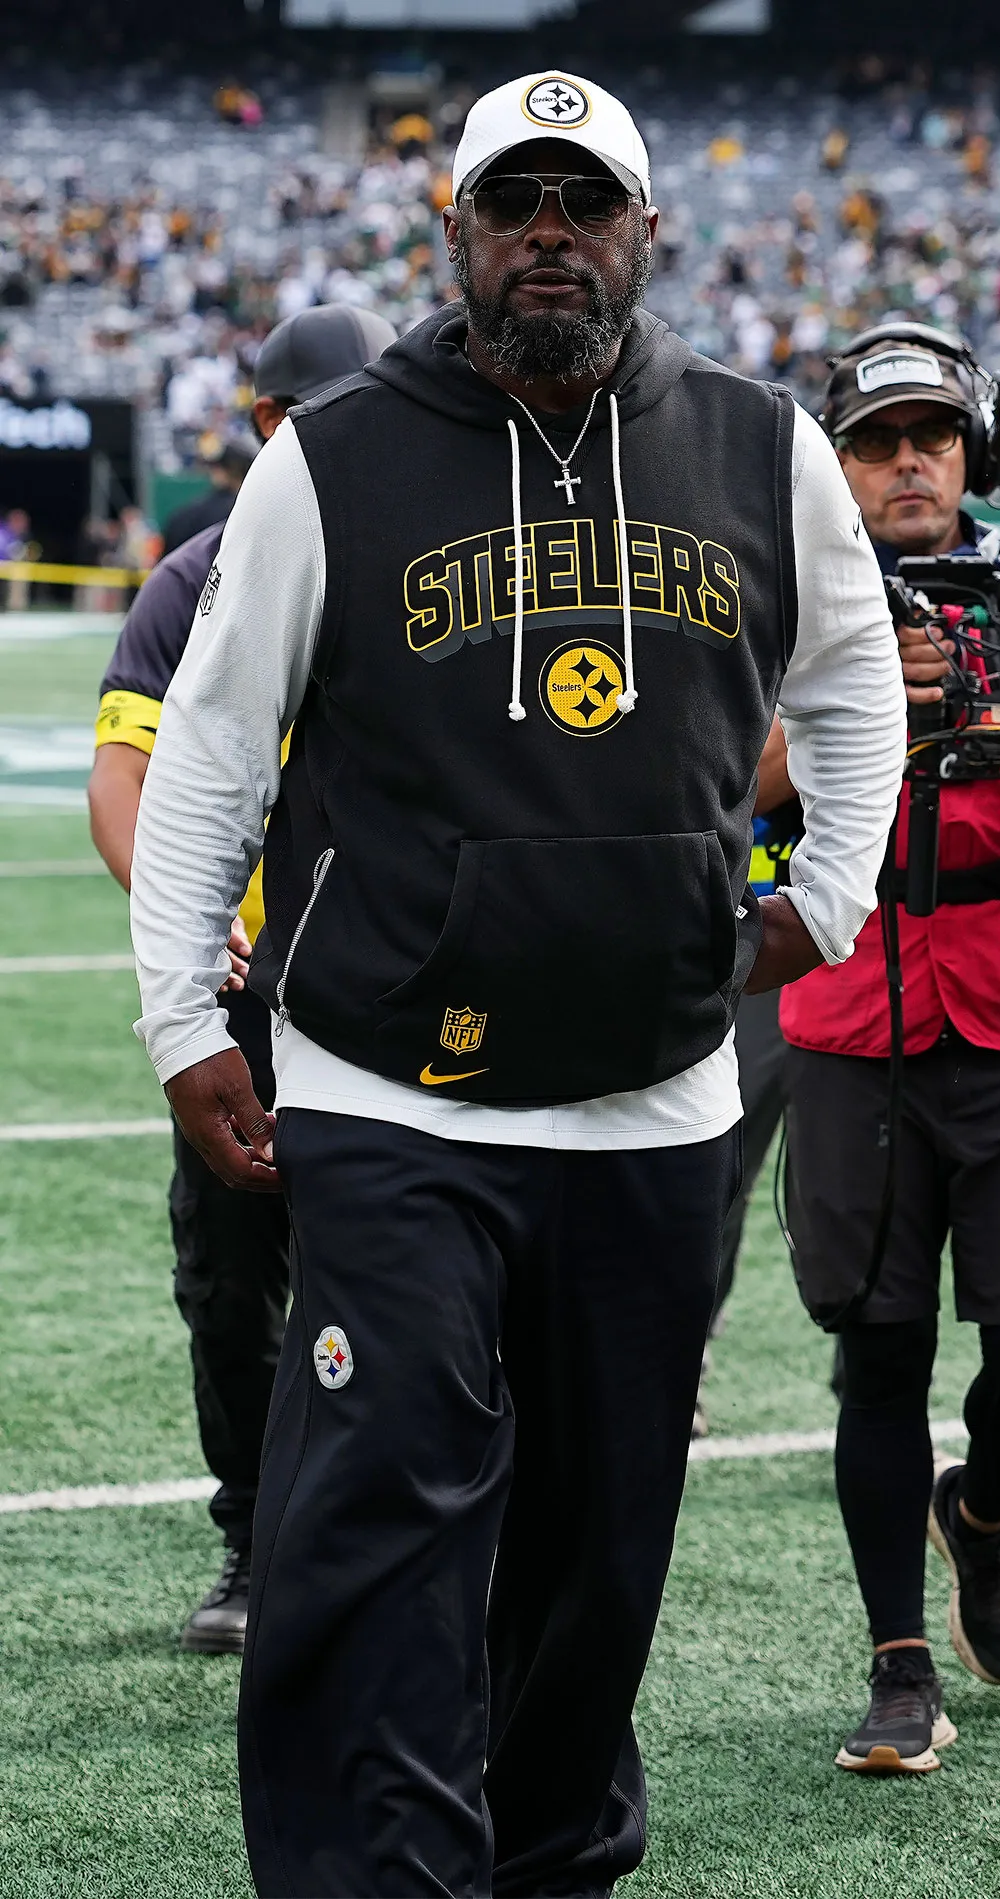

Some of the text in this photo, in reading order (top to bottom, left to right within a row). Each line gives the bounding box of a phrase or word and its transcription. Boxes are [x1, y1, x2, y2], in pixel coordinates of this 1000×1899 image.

[403, 518, 741, 652] STEELERS
[551, 682, 582, 692] Steelers
[444, 1026, 478, 1048] NFL
